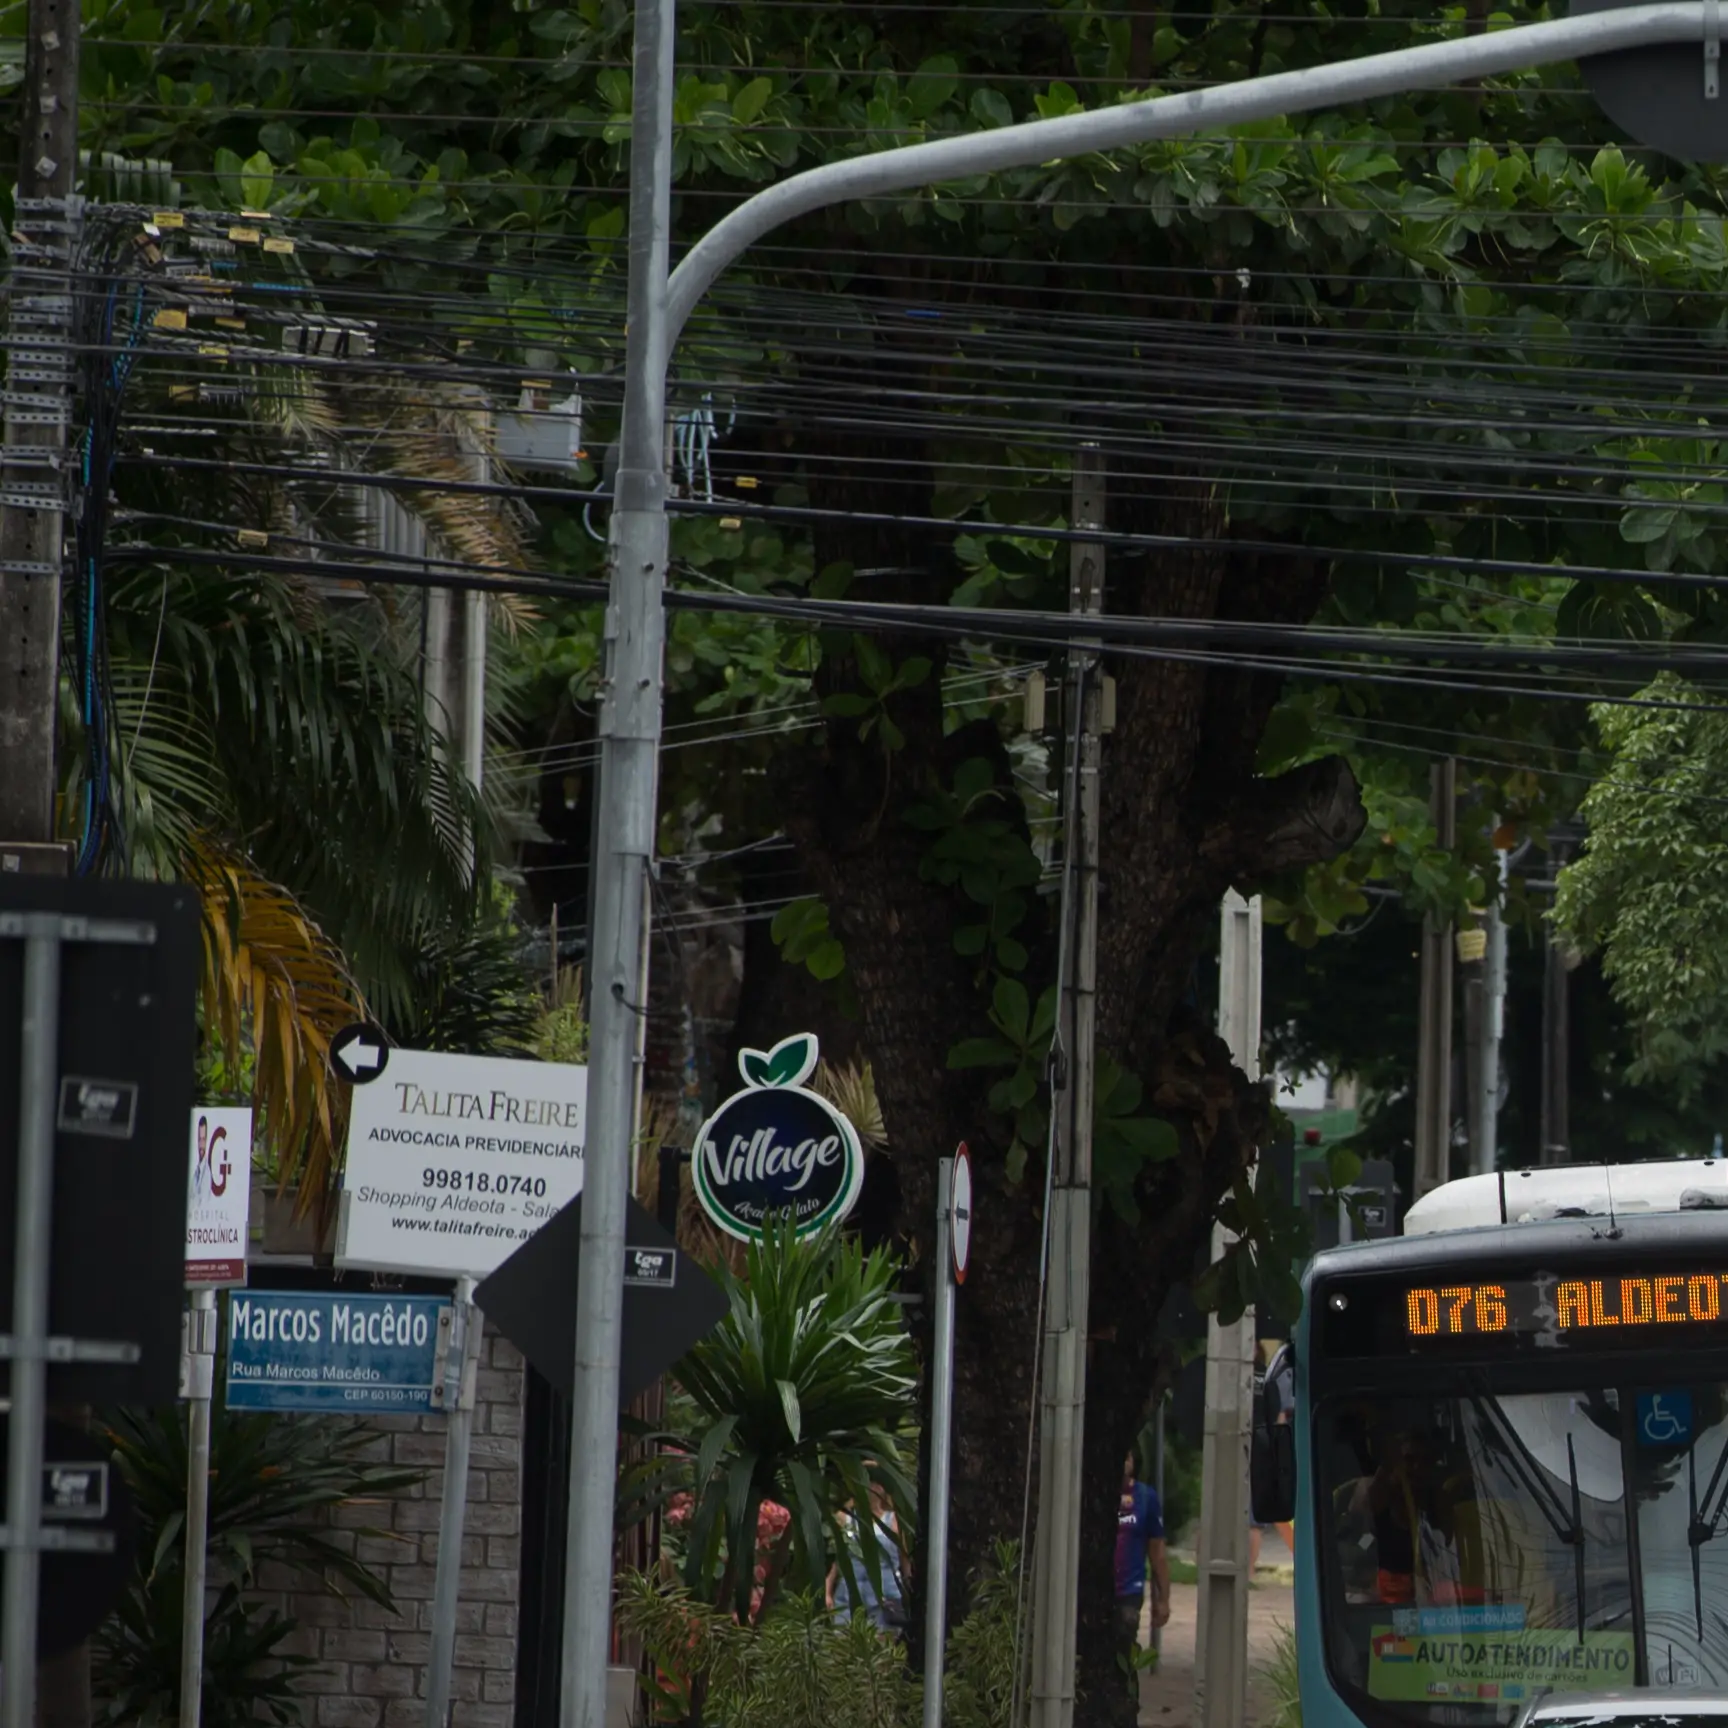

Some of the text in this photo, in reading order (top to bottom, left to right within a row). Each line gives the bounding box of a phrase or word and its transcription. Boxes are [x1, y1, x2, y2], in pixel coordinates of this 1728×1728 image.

[395, 1082, 578, 1128] TALITA FREIRE
[369, 1128, 460, 1148] ADVOCACIA
[703, 1127, 841, 1192] Village
[422, 1168, 546, 1198] 99818.0740
[357, 1186, 437, 1212] Shopping
[440, 1194, 505, 1214] Aldeota
[781, 1198, 820, 1220] Glato
[231, 1299, 428, 1346] Marcos Macêdo
[1406, 1285, 1508, 1335] 076
[232, 1362, 380, 1380] Rua Marcos Macêdo
[344, 1389, 368, 1400] CEP
[1416, 1641, 1629, 1671] AUTOATENDIMENTO
[1447, 1667, 1468, 1678] Uso
[1471, 1666, 1524, 1680] exclusivo
